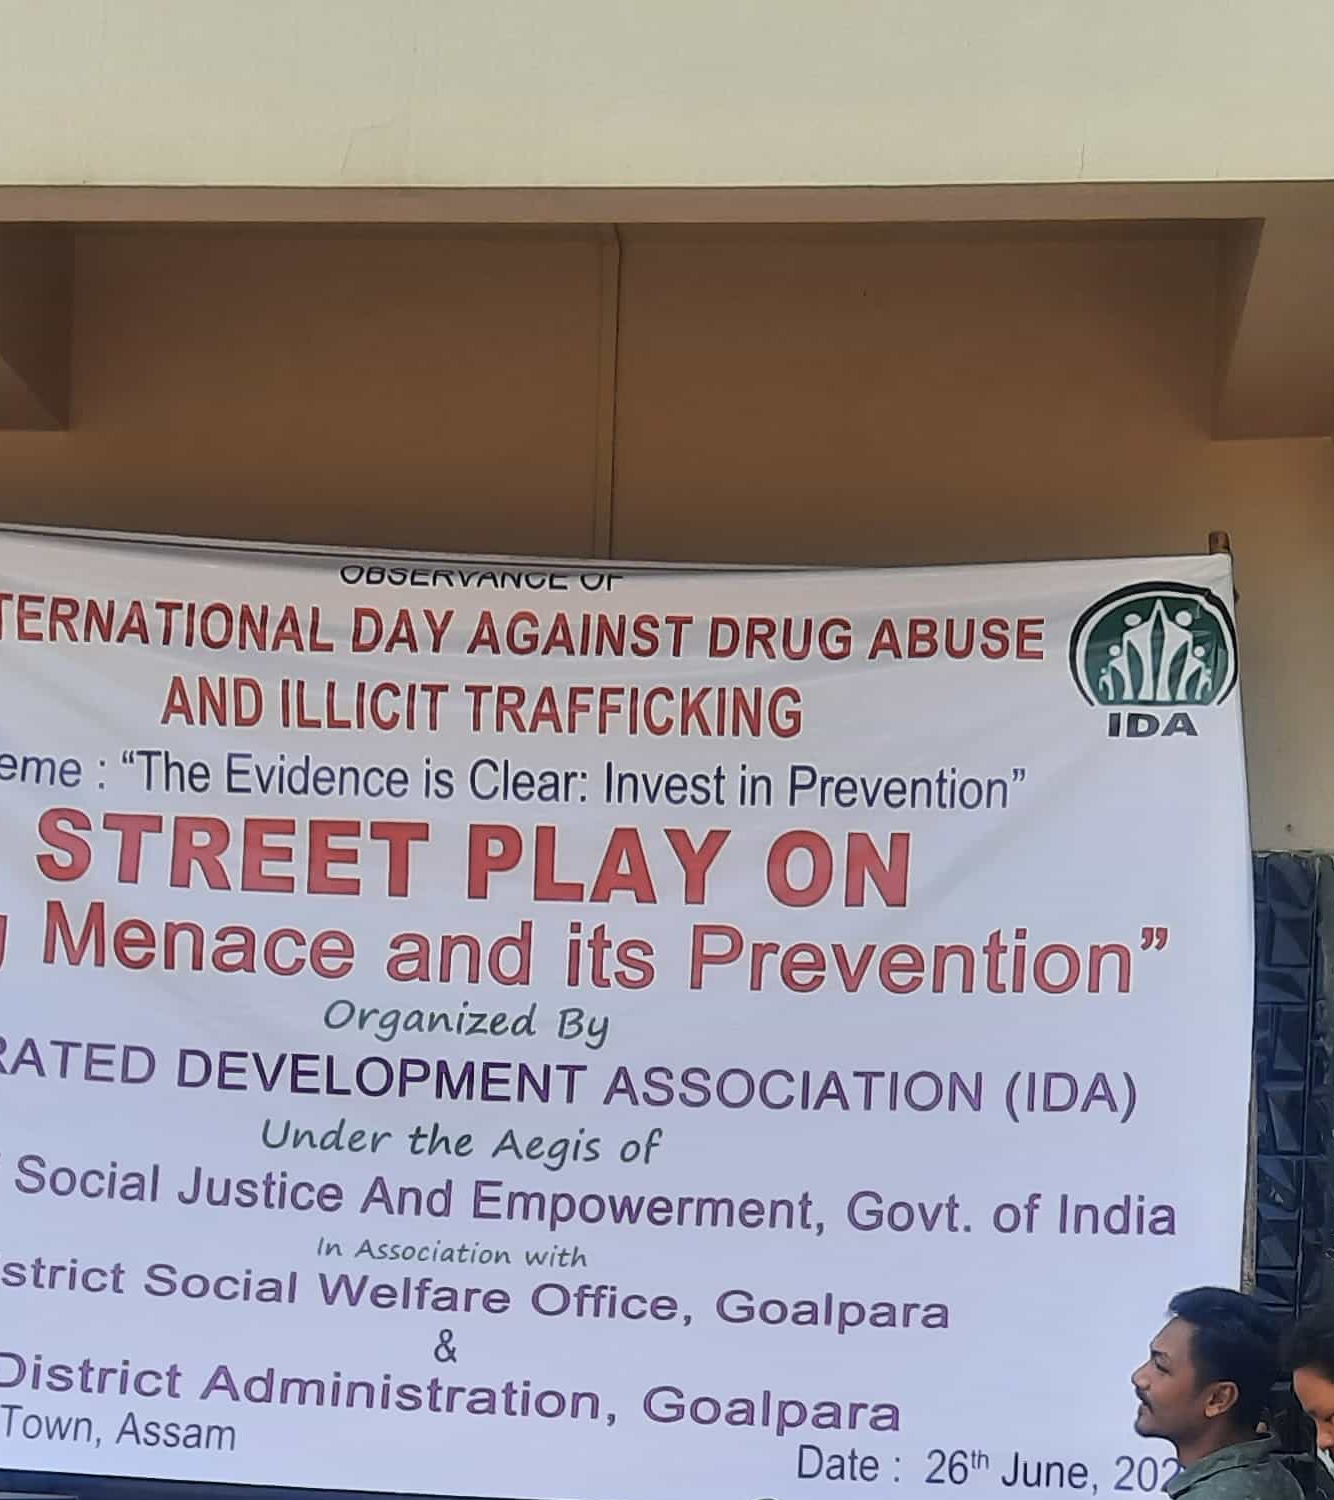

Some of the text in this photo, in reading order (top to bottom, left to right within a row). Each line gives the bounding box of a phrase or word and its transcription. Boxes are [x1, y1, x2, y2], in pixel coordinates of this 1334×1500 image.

[351, 606, 453, 655] DAY
[467, 610, 694, 659] AGAINST
[707, 614, 853, 662] DRUG
[868, 616, 1045, 661] ABUSE
[161, 675, 803, 738] AND ILLICIT TRAFFICKING
[1106, 711, 1199, 738] IDA
[122, 749, 211, 794] “The
[225, 751, 409, 798] Evidence
[424, 757, 454, 799] is
[469, 758, 588, 802] Clear:
[606, 761, 726, 806] Invest
[739, 762, 773, 807] in
[789, 764, 1027, 810] Prevention”
[36, 806, 911, 908] STREET PLAY ON
[43, 900, 356, 980] Menace
[385, 920, 534, 985] and
[566, 921, 657, 989] its
[689, 923, 1169, 995] Prevention”
[323, 998, 610, 1050] Organized By
[176, 1048, 588, 1106] DEVELOPMENT
[603, 1065, 984, 1114] ASSOCIATION
[1005, 1070, 1139, 1124] (IDA)
[261, 1117, 664, 1172] Under the Aegis of
[13, 1152, 160, 1203] Social
[177, 1165, 344, 1213] Justice
[359, 1175, 453, 1218] And
[471, 1179, 825, 1236] Empowerment,
[846, 1189, 972, 1234] Govt.
[992, 1193, 1041, 1236] of
[1057, 1193, 1178, 1237] India
[316, 1236, 588, 1269] In Association with
[143, 1262, 297, 1305] Social
[318, 1272, 511, 1314] Welfare
[531, 1282, 692, 1328] Office,
[715, 1288, 950, 1335] Goalpara
[433, 1328, 457, 1364] &
[0, 1404, 102, 1447] Town,
[115, 1411, 237, 1452] Assam
[200, 1364, 616, 1427] Administration,
[643, 1384, 901, 1437] Goalpara
[797, 1444, 880, 1483] Date
[924, 1448, 990, 1487] 26th
[1000, 1451, 1099, 1495] June,
[1113, 1455, 1181, 1494] 202
